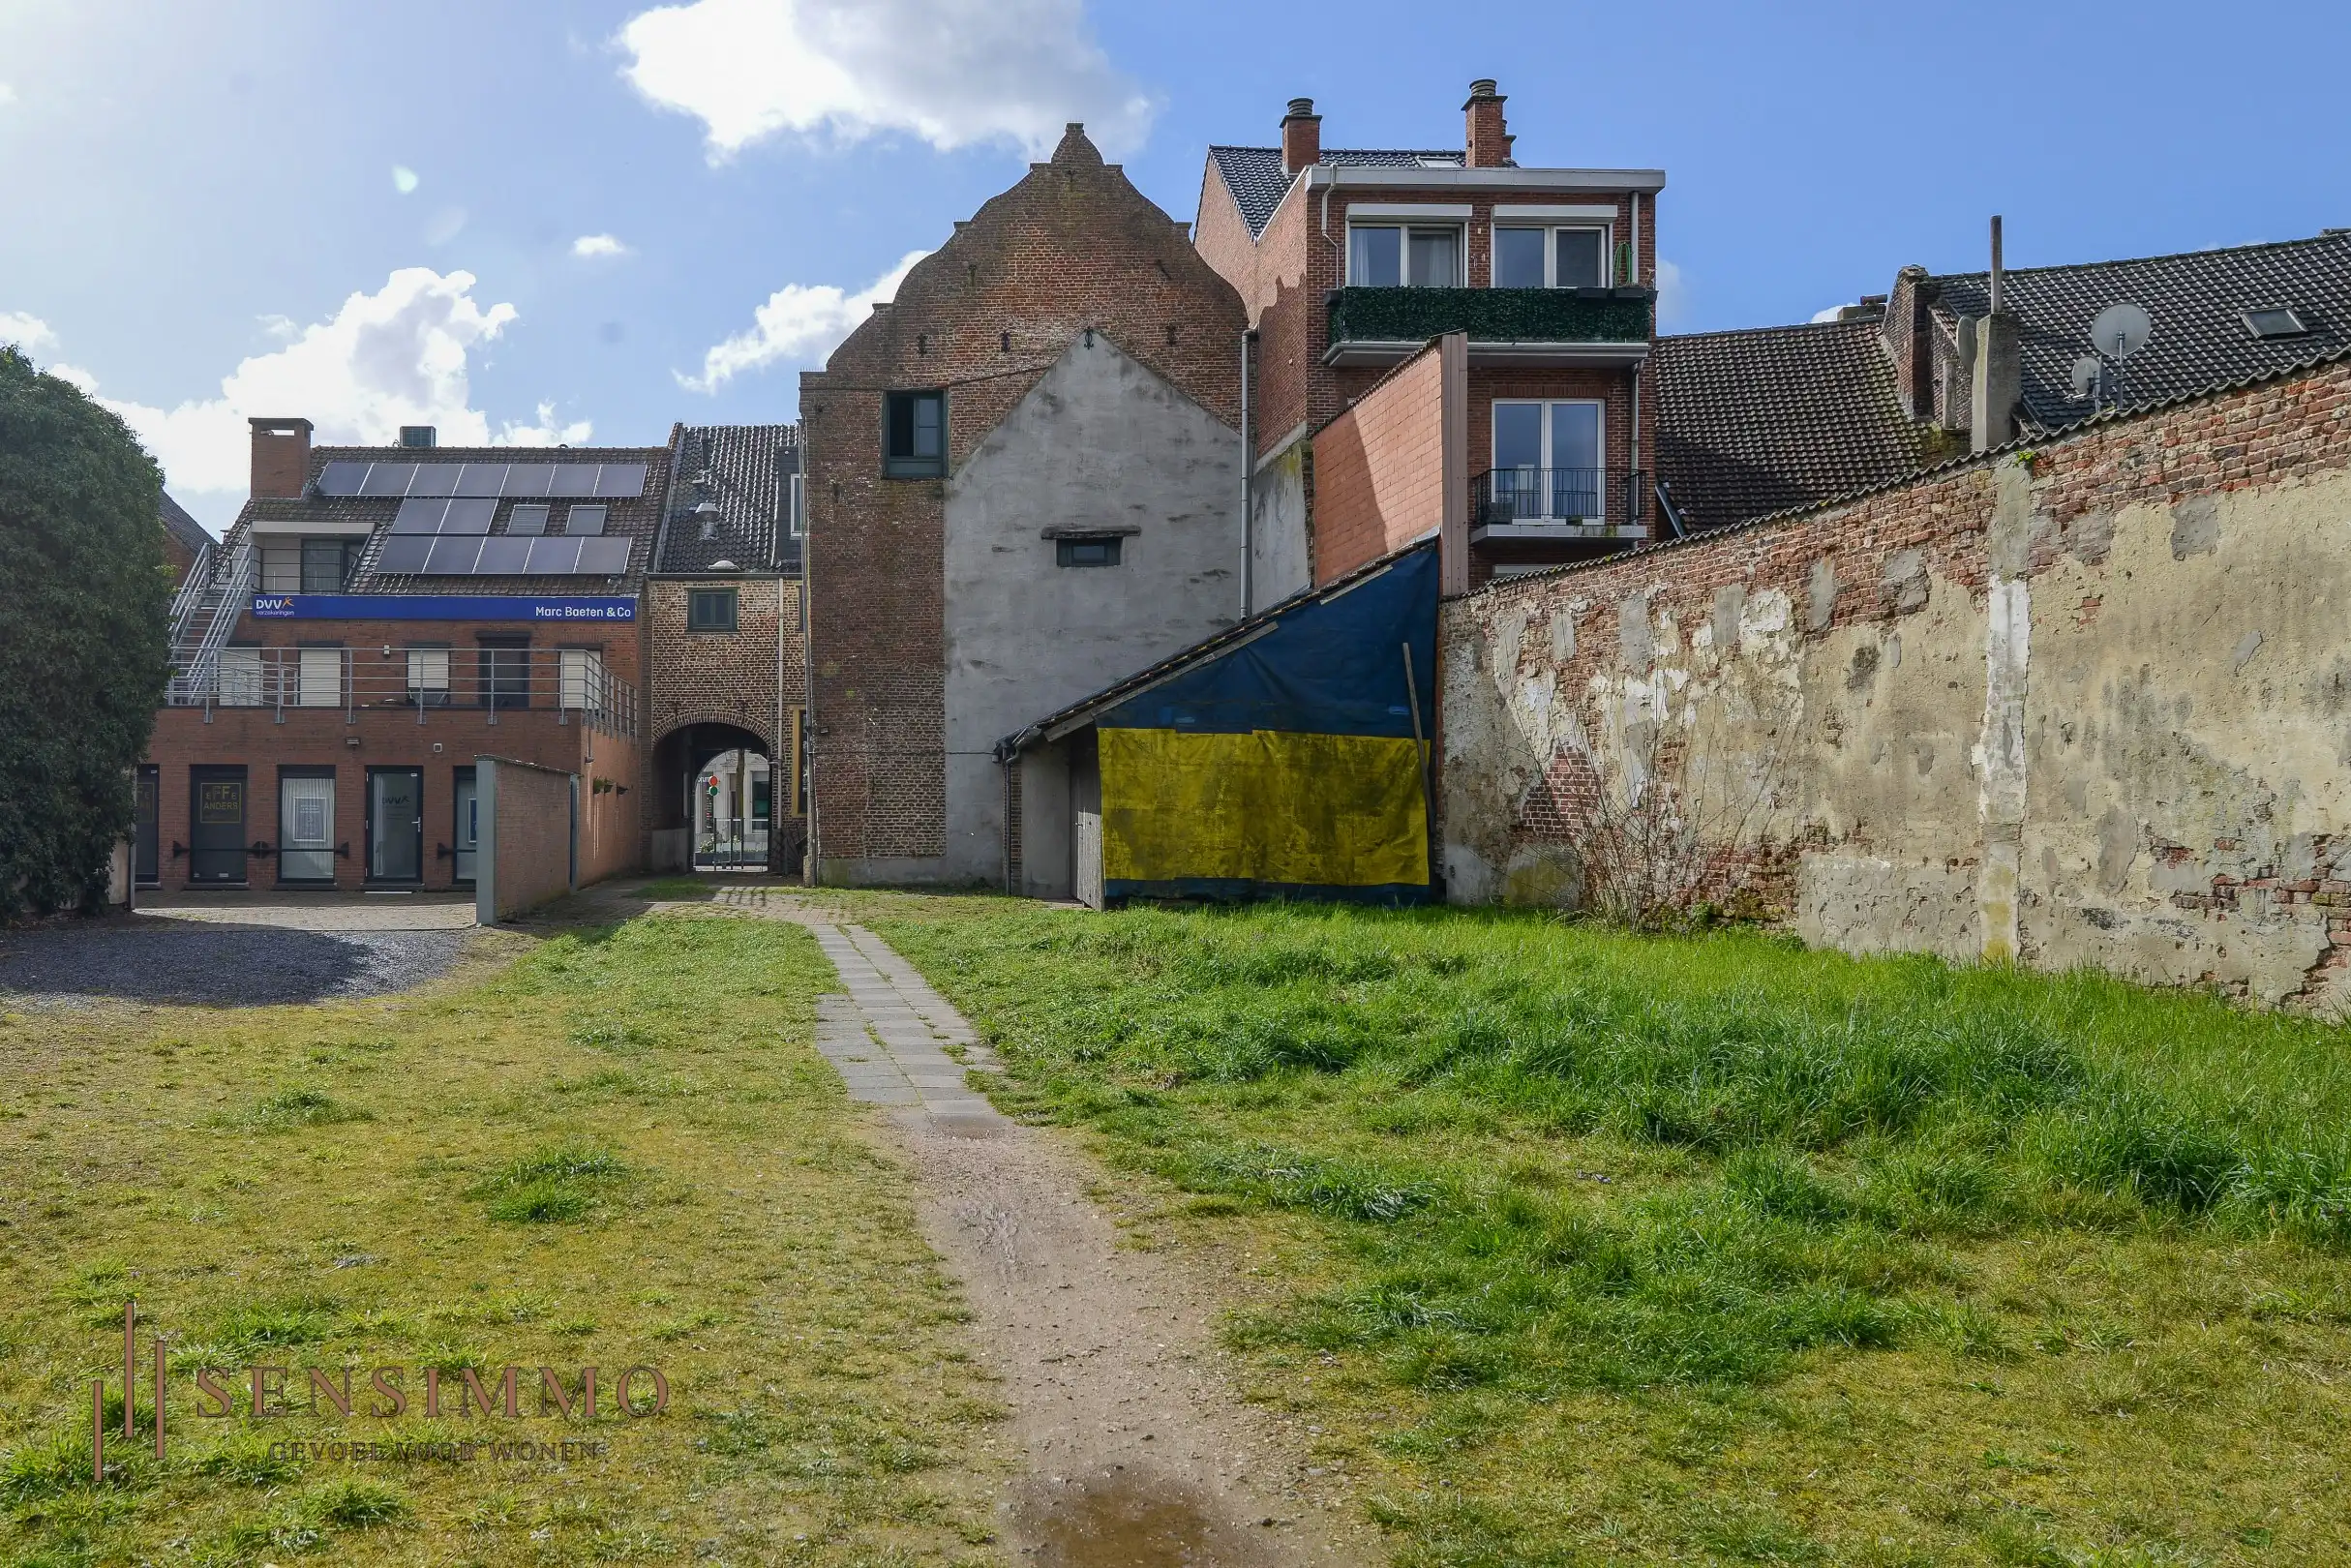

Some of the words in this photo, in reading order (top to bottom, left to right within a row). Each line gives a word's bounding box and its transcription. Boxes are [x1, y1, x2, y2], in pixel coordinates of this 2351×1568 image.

[256, 599, 283, 610] DVV
[535, 606, 562, 617] Marc
[565, 606, 604, 618] Baeten
